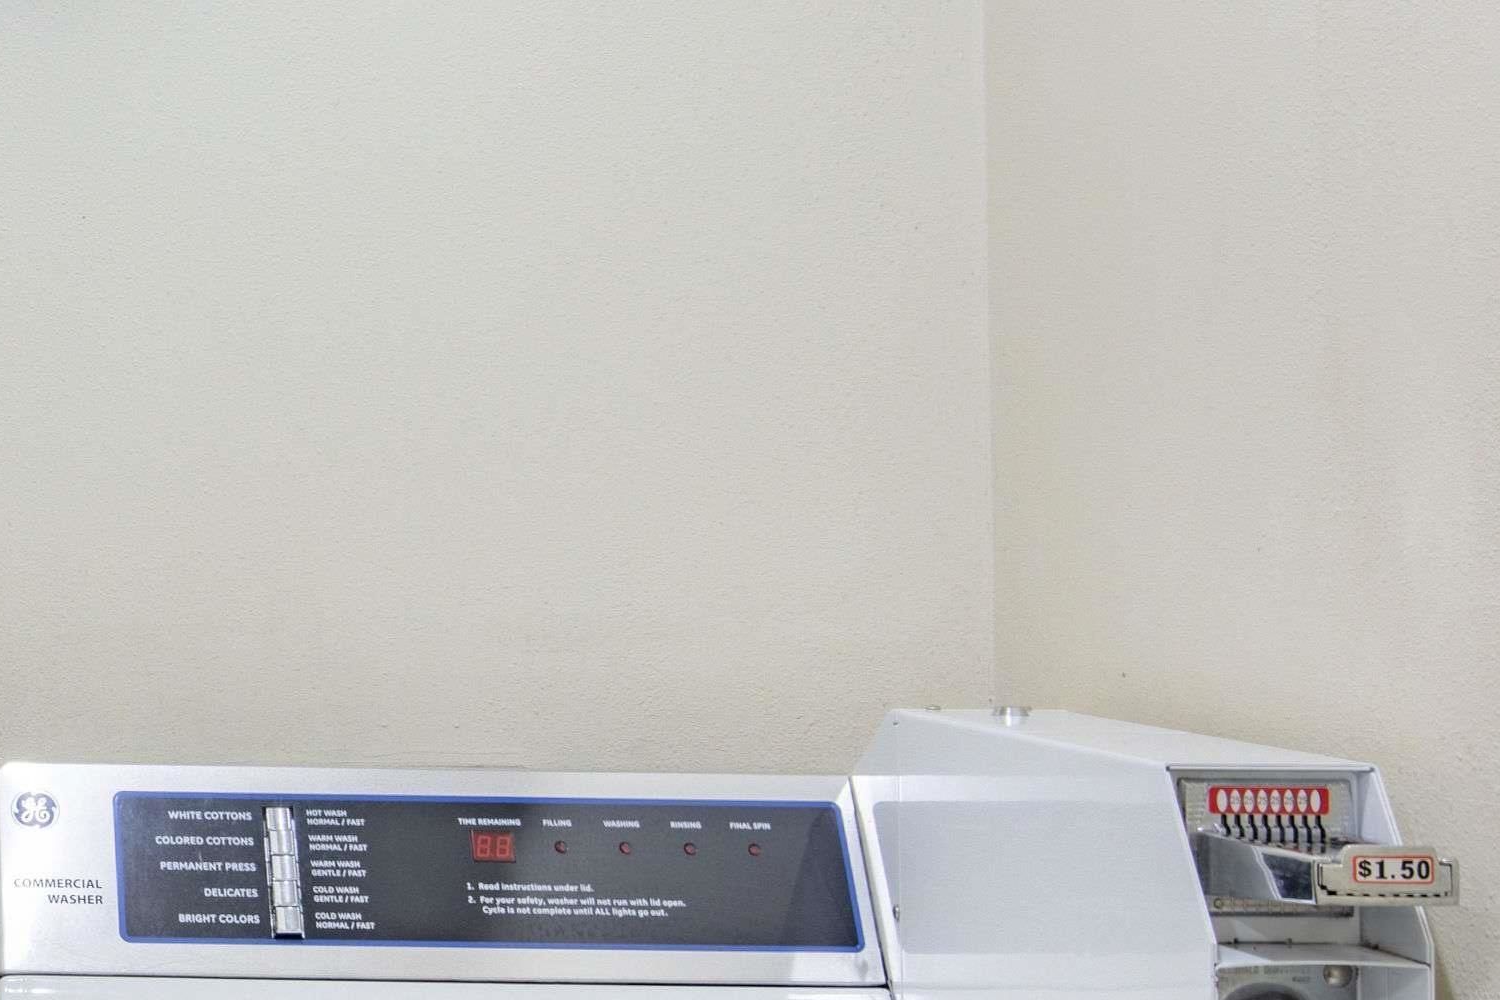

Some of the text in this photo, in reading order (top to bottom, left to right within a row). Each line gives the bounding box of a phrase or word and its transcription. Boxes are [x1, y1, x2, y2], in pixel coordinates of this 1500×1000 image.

[168, 811, 252, 821] WHITE COTTONS
[306, 809, 347, 817] HOT WASH
[307, 818, 340, 826] NORMAL
[458, 818, 521, 826] TIME REMAINING
[542, 819, 572, 827] FILLING
[603, 820, 640, 828] WASHING
[670, 821, 702, 829] RINSING
[729, 822, 771, 830] FINAL SPIN
[155, 836, 254, 846] COLORED COTTONS
[160, 861, 256, 872] PERMANENT PRESS
[1358, 860, 1430, 879] $1.50
[13, 879, 103, 889] COMMERCIAL
[501, 883, 552, 892] instructions
[554, 884, 578, 892] under
[580, 884, 594, 892] lid.
[204, 888, 259, 898] DELICATES
[313, 886, 359, 894] COLD WASH
[48, 894, 103, 905] WASHER
[468, 896, 476, 904] 2.
[479, 896, 494, 904] For
[495, 898, 515, 906] your
[517, 897, 545, 906] safety,
[547, 897, 579, 905] washer
[597, 898, 611, 906] not
[630, 898, 648, 906] with
[662, 900, 686, 908] open.
[315, 912, 362, 920] COLD WASH
[482, 906, 505, 915] Cycle
[506, 906, 515, 914] is
[532, 907, 572, 916] complete
[573, 907, 593, 915] until
[612, 908, 636, 917] lights
[638, 909, 649, 918] go
[650, 909, 668, 917] out.
[178, 914, 260, 924] BRIGHT COLORS
[316, 922, 349, 930] NORMAL
[356, 922, 375, 930] FAST
